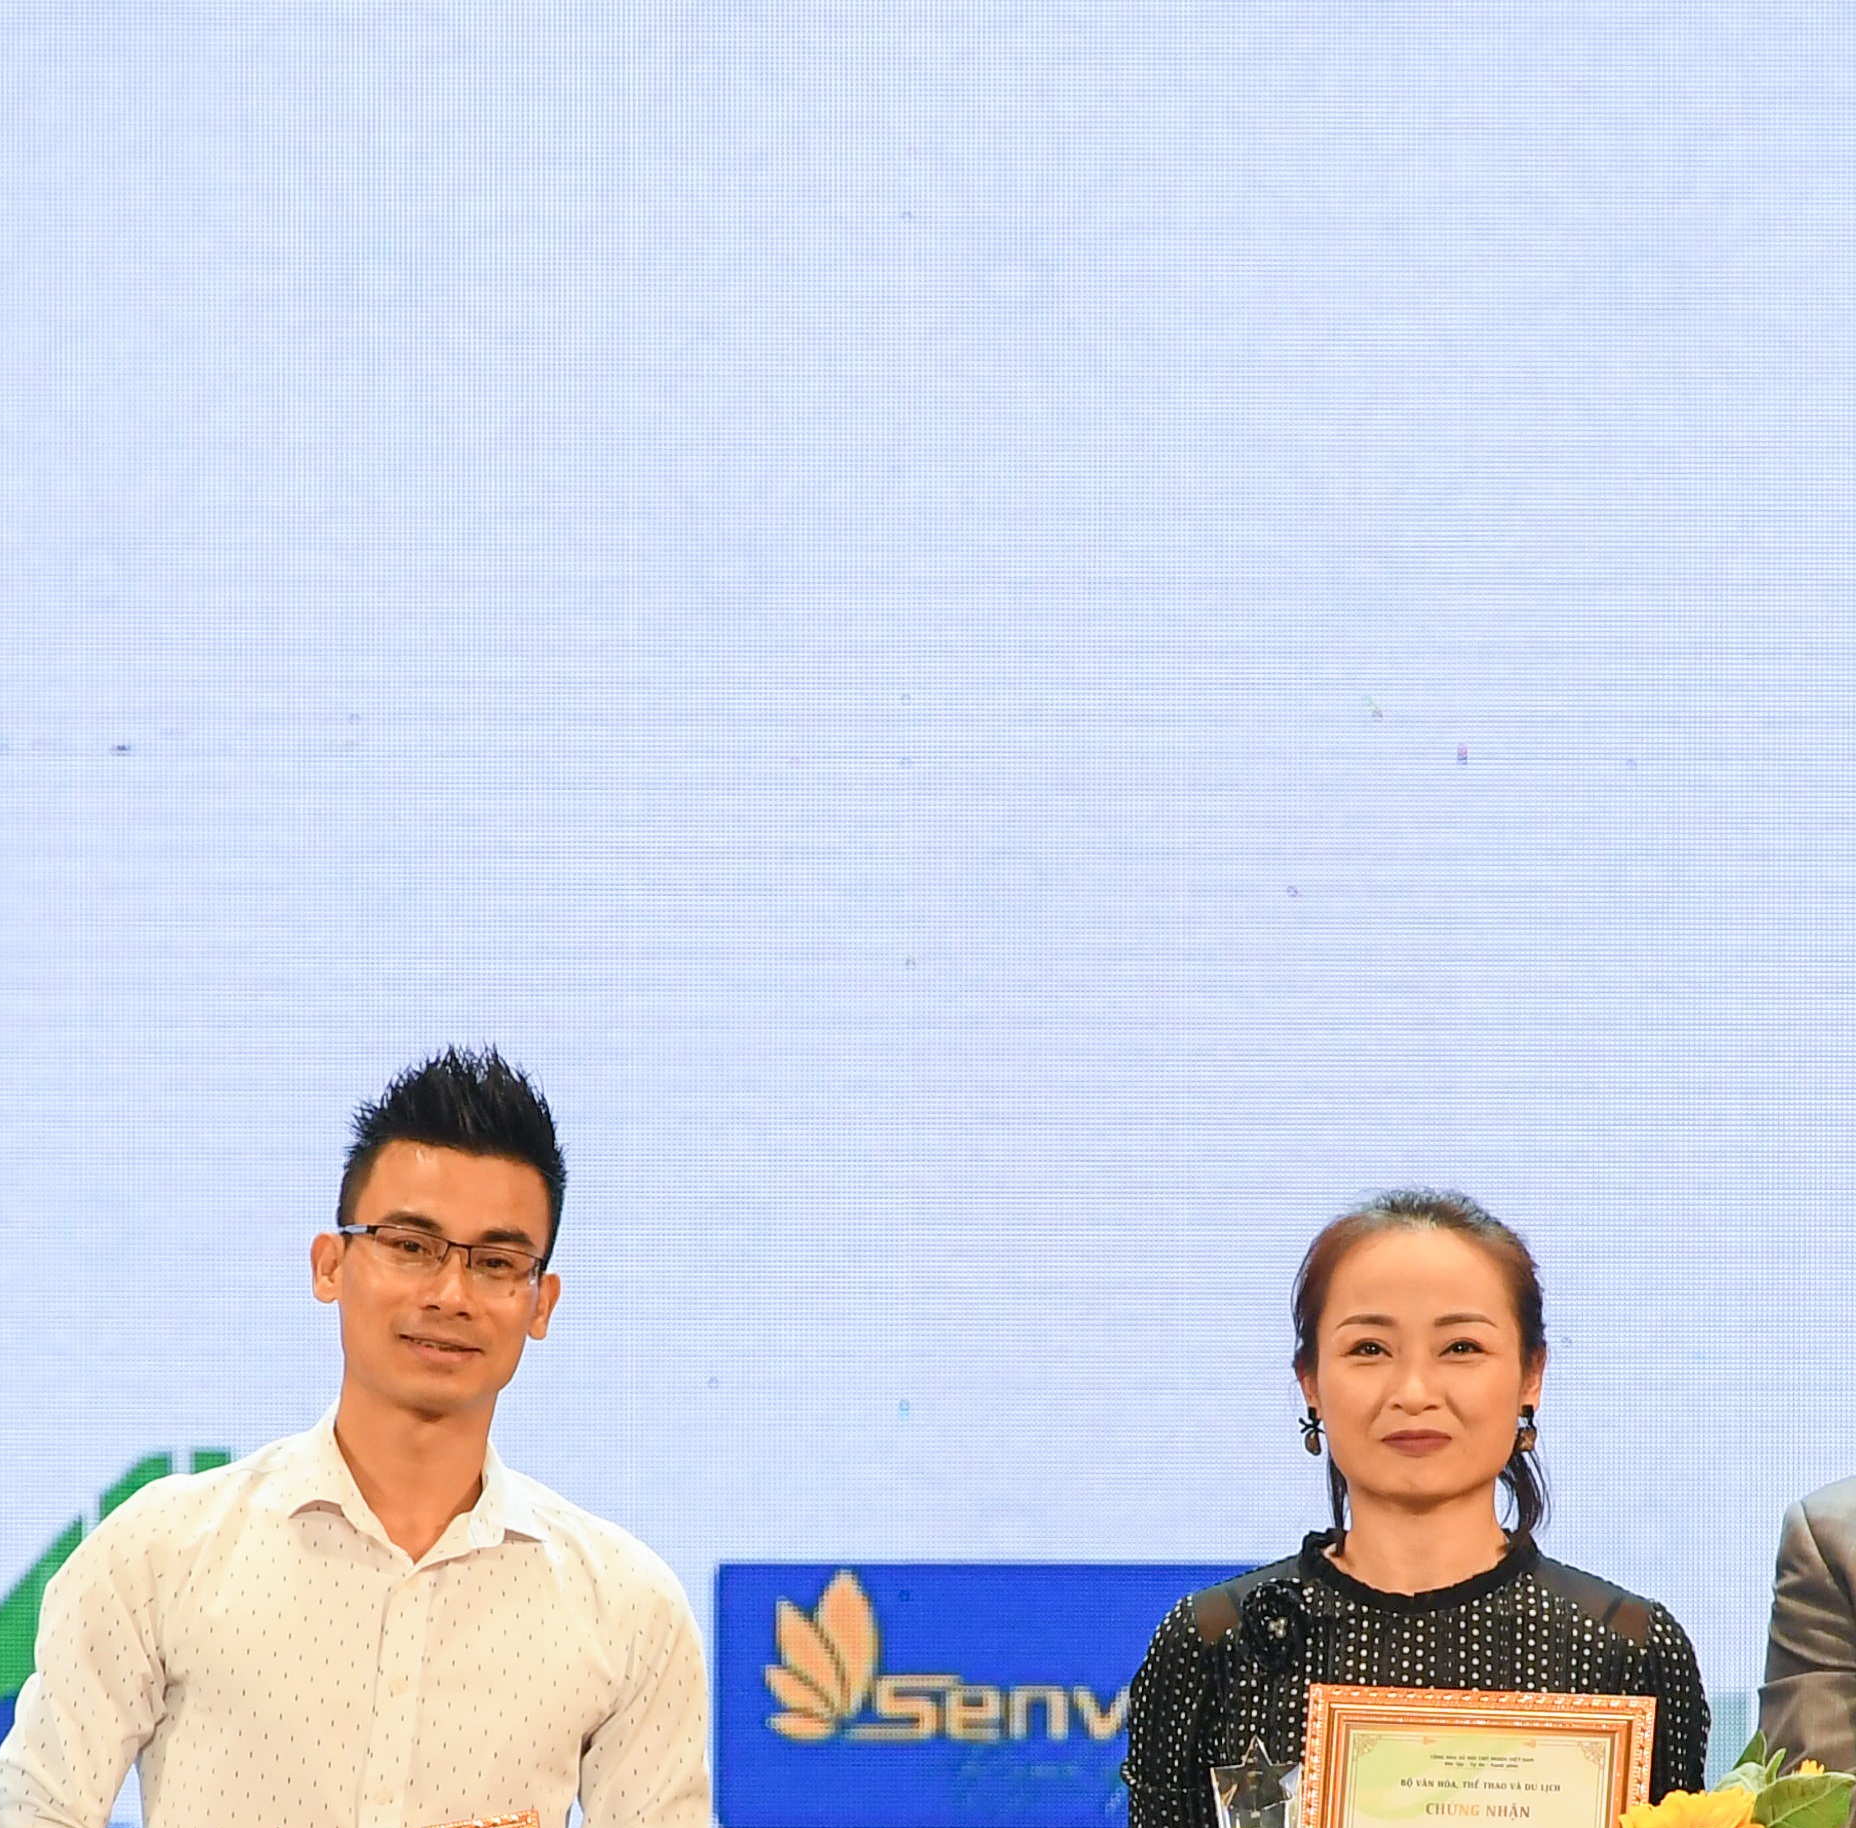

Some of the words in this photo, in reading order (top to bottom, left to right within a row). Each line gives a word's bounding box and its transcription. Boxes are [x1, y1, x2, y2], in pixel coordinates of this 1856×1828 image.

[1483, 1781, 1507, 1790] THAO
[1525, 1783, 1537, 1791] DU
[1486, 1802, 1531, 1821] NHẬN
